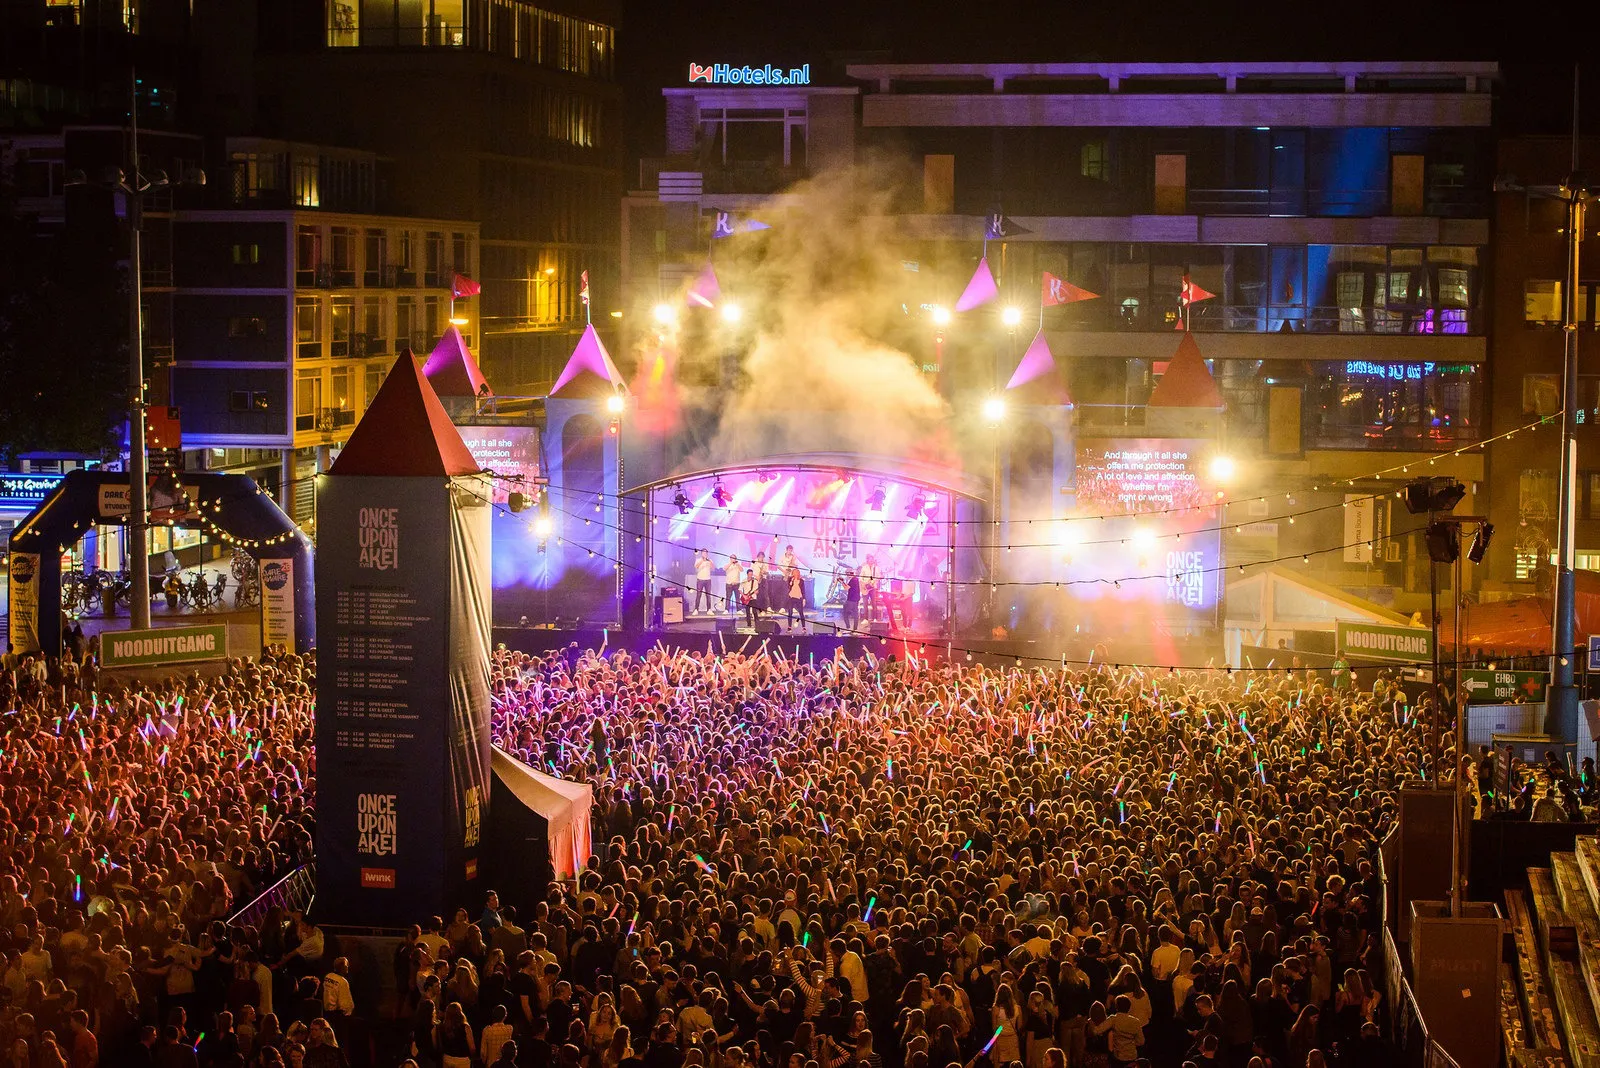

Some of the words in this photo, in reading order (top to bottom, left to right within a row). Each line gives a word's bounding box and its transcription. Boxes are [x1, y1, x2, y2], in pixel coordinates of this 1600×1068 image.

[713, 63, 811, 85] Hotels.nl
[488, 439, 496, 447] all
[498, 439, 512, 447] she
[473, 449, 510, 458] protection
[1104, 451, 1120, 459] And
[1122, 451, 1152, 461] through
[1154, 451, 1159, 459] it
[1161, 451, 1170, 459] all
[1173, 451, 1187, 459] she
[1107, 462, 1129, 470] offers
[1146, 462, 1184, 471] protection
[104, 491, 124, 499] DARE
[1122, 483, 1155, 491] Whether
[1118, 494, 1136, 503] right
[1148, 495, 1172, 504] wrong
[359, 507, 398, 528] ONCE
[813, 514, 857, 536] UPON
[358, 528, 398, 548] UPON
[1166, 551, 1204, 569] ONCE
[1166, 568, 1203, 587] UPON
[113, 633, 215, 658] NOODUITGANG
[1346, 630, 1428, 654] NOODUITGANG
[1495, 673, 1516, 684] EHBO
[357, 793, 397, 814] ONCE
[357, 813, 397, 834] UPON
[365, 872, 391, 883] iwink
